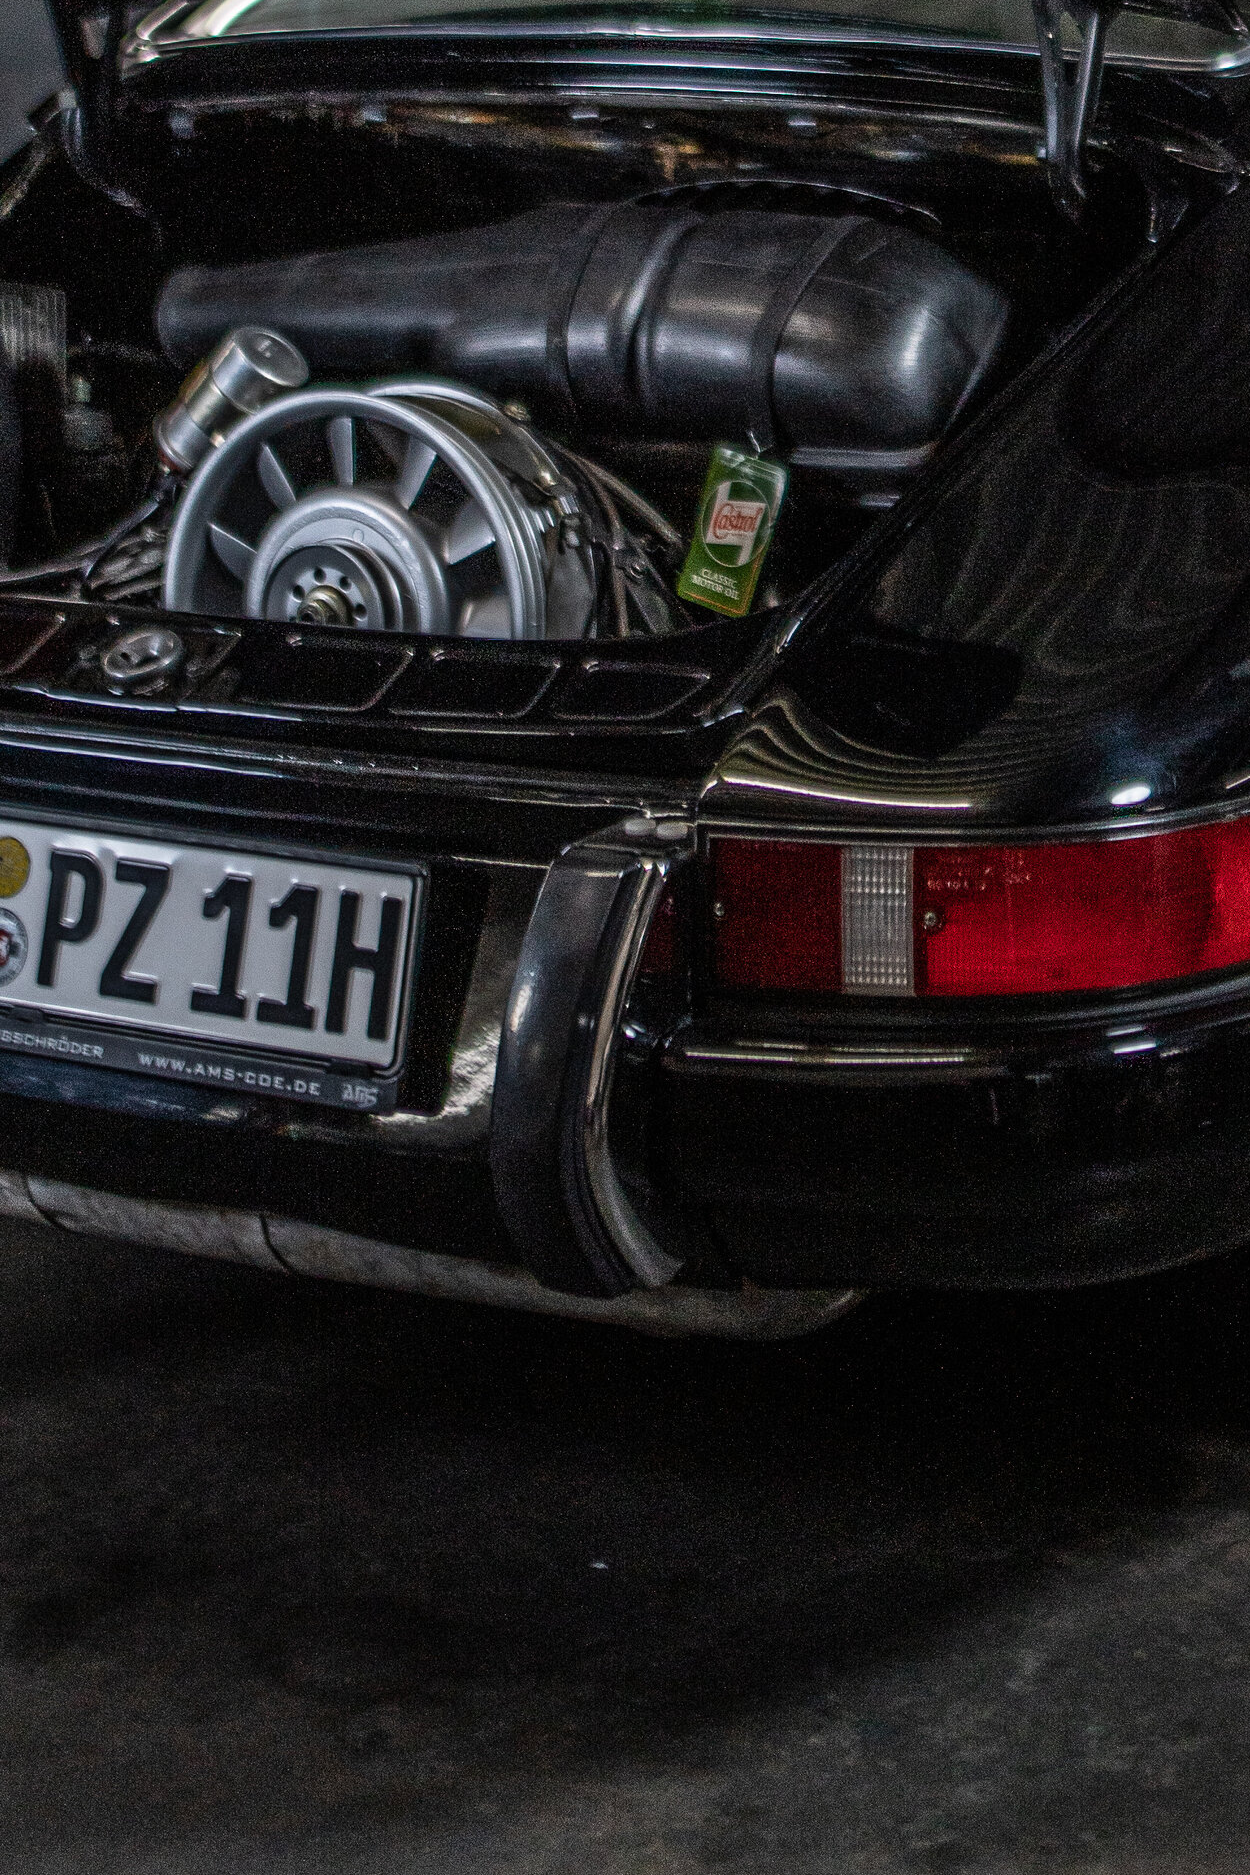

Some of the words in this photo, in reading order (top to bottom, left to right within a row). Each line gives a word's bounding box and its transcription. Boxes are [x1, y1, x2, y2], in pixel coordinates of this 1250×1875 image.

[713, 503, 764, 540] Castrol
[691, 575, 724, 594] MOTOR
[724, 588, 739, 600] OIL
[701, 568, 738, 589] CLASSIC
[36, 845, 172, 1005] PZ
[189, 871, 403, 1041] 11H
